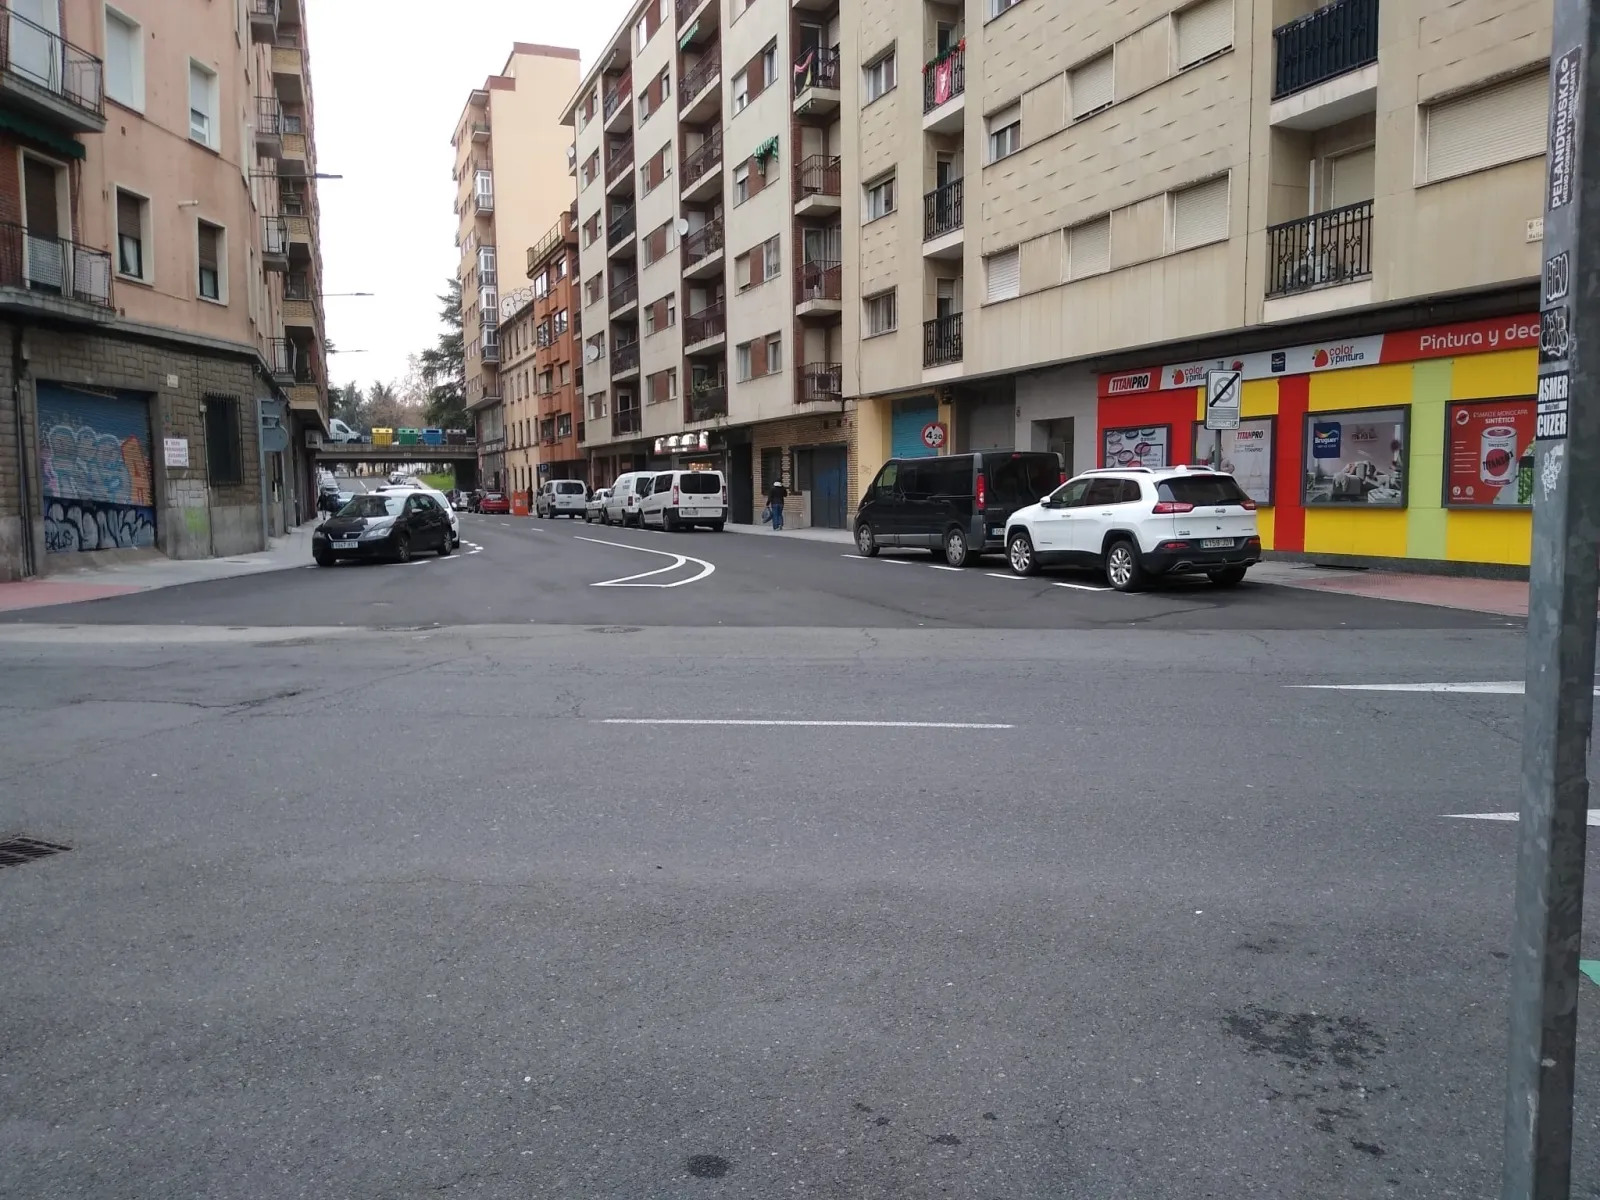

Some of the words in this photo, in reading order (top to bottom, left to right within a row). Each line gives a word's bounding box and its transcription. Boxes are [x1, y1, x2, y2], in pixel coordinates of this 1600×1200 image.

[1552, 71, 1570, 208] PELANDRUSKA
[1420, 332, 1483, 351] Pintura
[1488, 329, 1499, 347] y
[1504, 323, 1540, 341] dec
[1329, 344, 1355, 357] color
[1184, 365, 1204, 376] color
[1112, 374, 1149, 391] TITANPRO
[1538, 375, 1568, 402] ASMER
[1237, 430, 1264, 440] TITANPRO
[1537, 412, 1567, 437] CUZER
